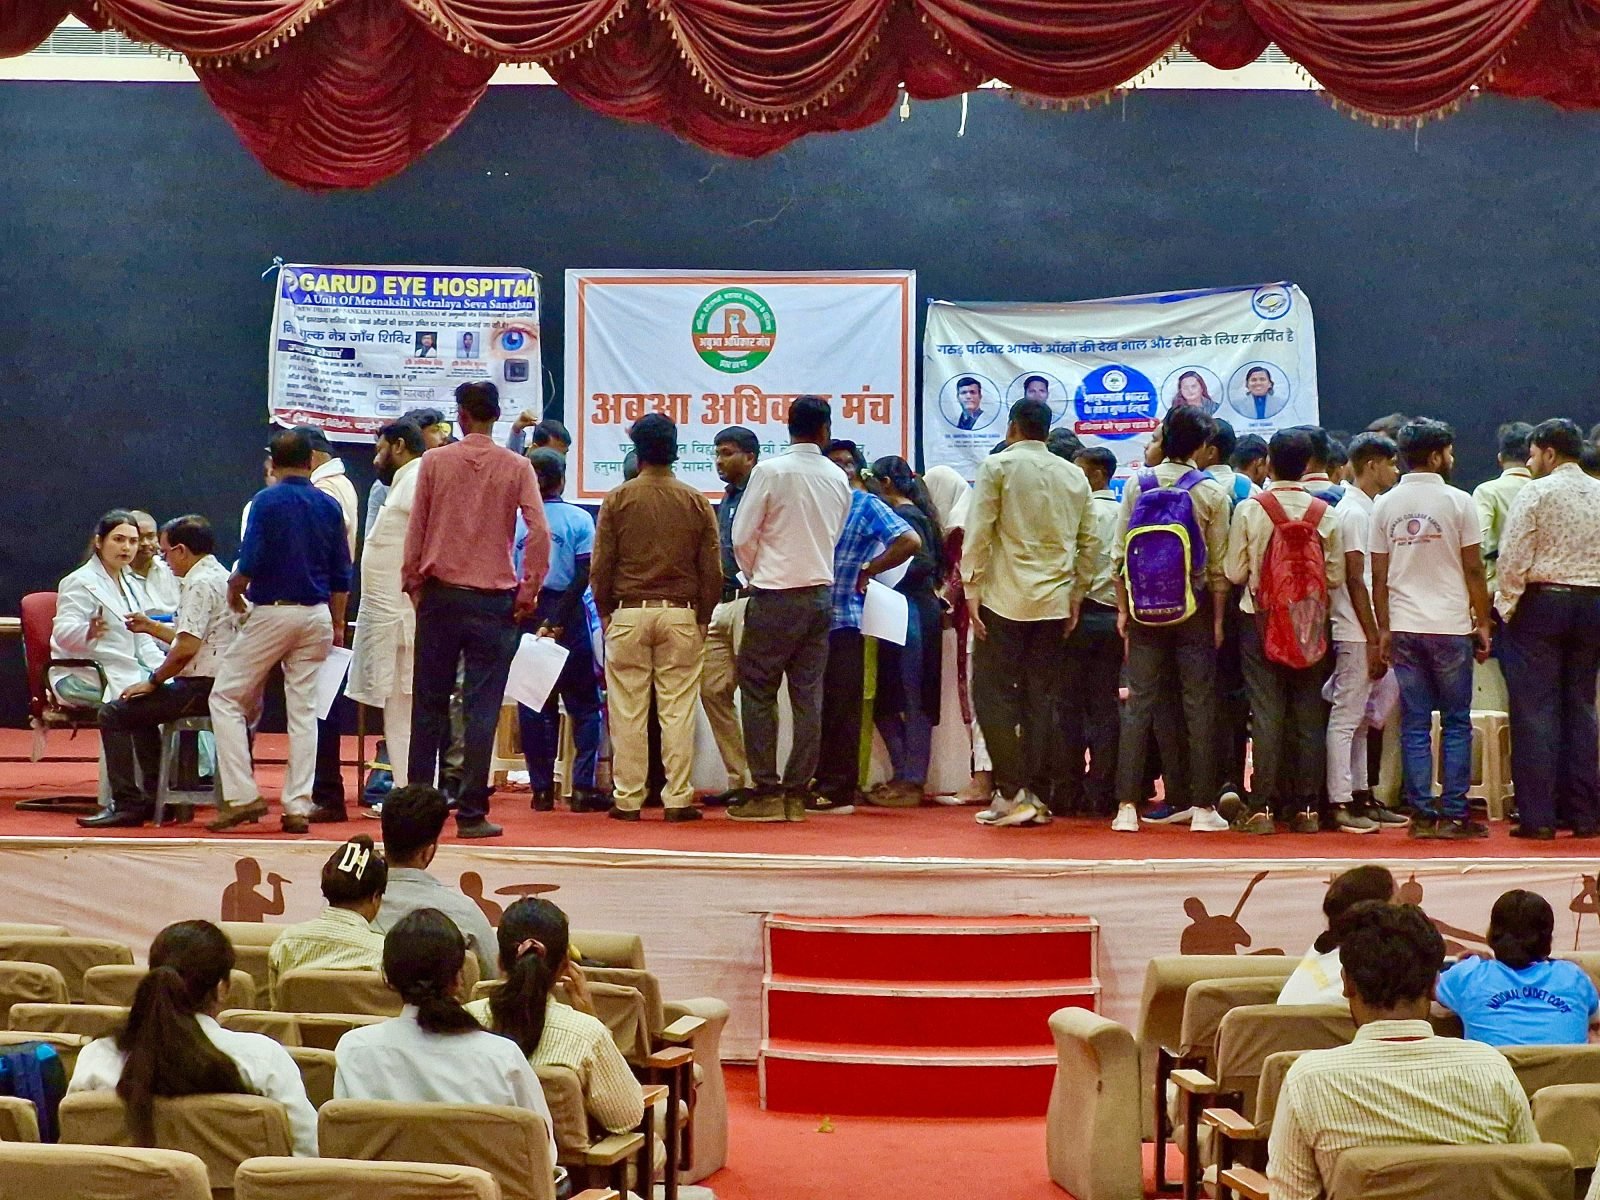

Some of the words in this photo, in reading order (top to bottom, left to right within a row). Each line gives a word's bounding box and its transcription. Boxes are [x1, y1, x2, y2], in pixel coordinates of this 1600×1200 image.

[299, 273, 377, 294] GARUD
[383, 275, 426, 296] EYE
[433, 277, 536, 297] HOSPITAL
[303, 294, 312, 303] A
[314, 295, 336, 305] Unit
[340, 295, 353, 305] Of
[354, 296, 410, 307] Meenakshi
[413, 298, 461, 310] Netralaya
[464, 299, 488, 309] Seva
[490, 299, 533, 310] Sansthan
[329, 328, 345, 342] नेत्र
[350, 329, 374, 342] जाँच
[379, 330, 411, 344] शिविर
[966, 341, 1004, 354] परिवार
[1007, 341, 1043, 354] आपके
[1079, 340, 1095, 353] की
[1121, 340, 1147, 351] भाल
[1150, 336, 1172, 349] और
[1174, 335, 1197, 348] सेवा
[1200, 333, 1213, 346] के
[1215, 332, 1240, 345] लिए
[1286, 328, 1294, 343] है
[591, 393, 692, 425] अबआ
[701, 385, 832, 425] अधिक
[841, 385, 894, 425] मंच
[593, 461, 624, 476] हनुमा
[682, 459, 713, 473] सामने
[1522, 987, 1548, 1000] CADET
[1547, 994, 1572, 1013] CORPS
